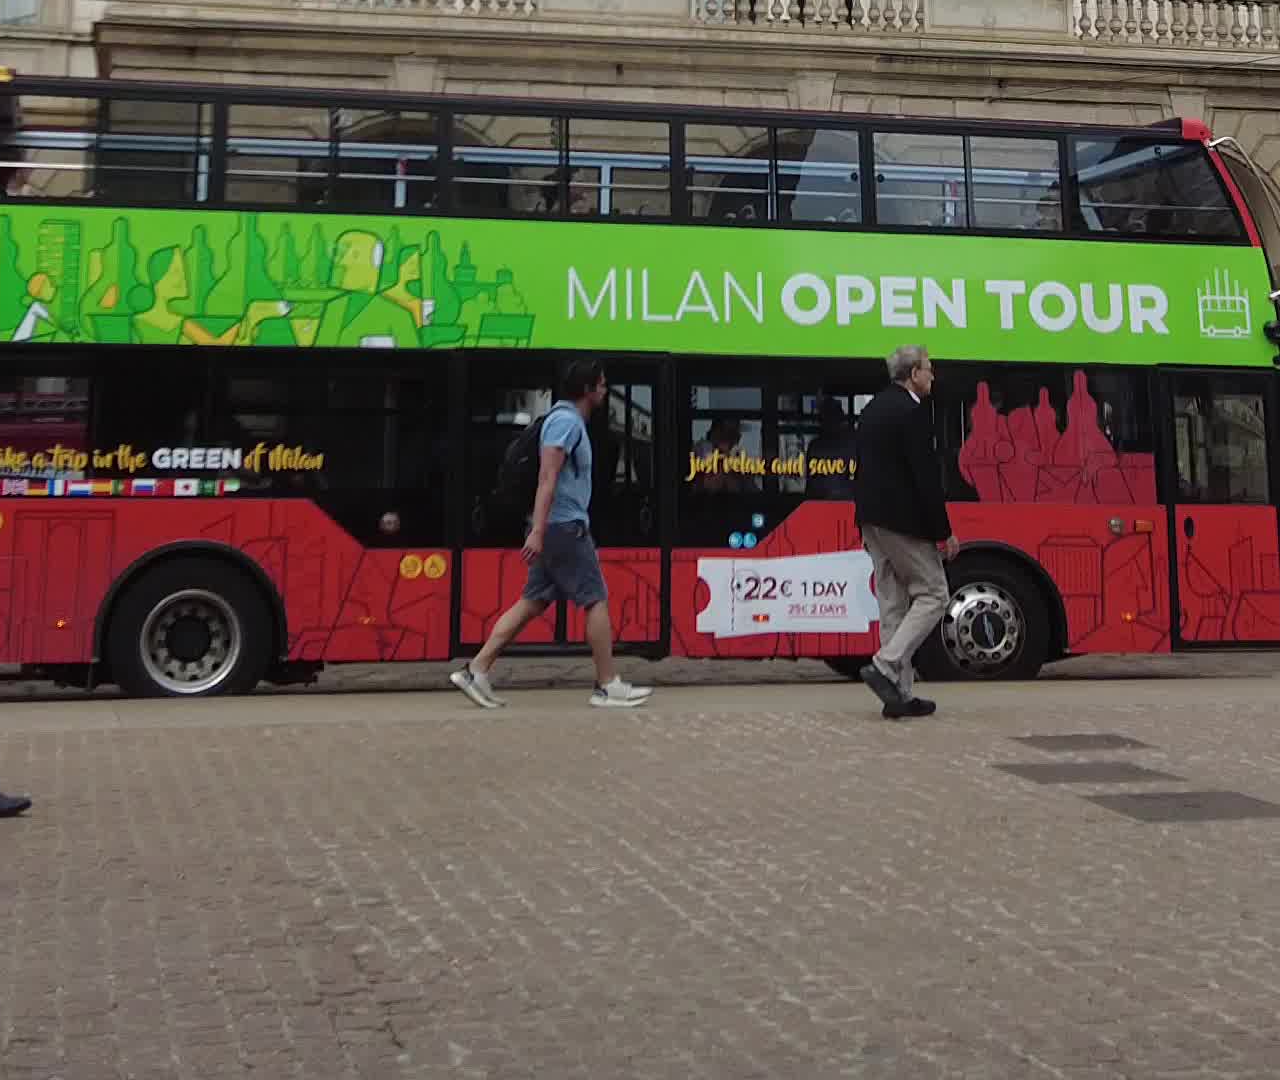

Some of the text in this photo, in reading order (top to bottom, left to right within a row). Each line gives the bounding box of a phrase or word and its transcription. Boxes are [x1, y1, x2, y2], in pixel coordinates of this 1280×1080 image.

[565, 266, 1170, 335] MILAN OPEN TOUR
[32, 452, 47, 469] a
[46, 443, 88, 471] trip
[93, 449, 113, 468] in
[113, 443, 146, 473] the
[151, 447, 242, 470] GREEN
[244, 442, 269, 473] of
[269, 443, 324, 471] Milan
[684, 448, 721, 482] just
[723, 450, 766, 475] relax
[771, 452, 804, 477] and
[809, 457, 846, 476] save
[813, 581, 848, 597] DAY
